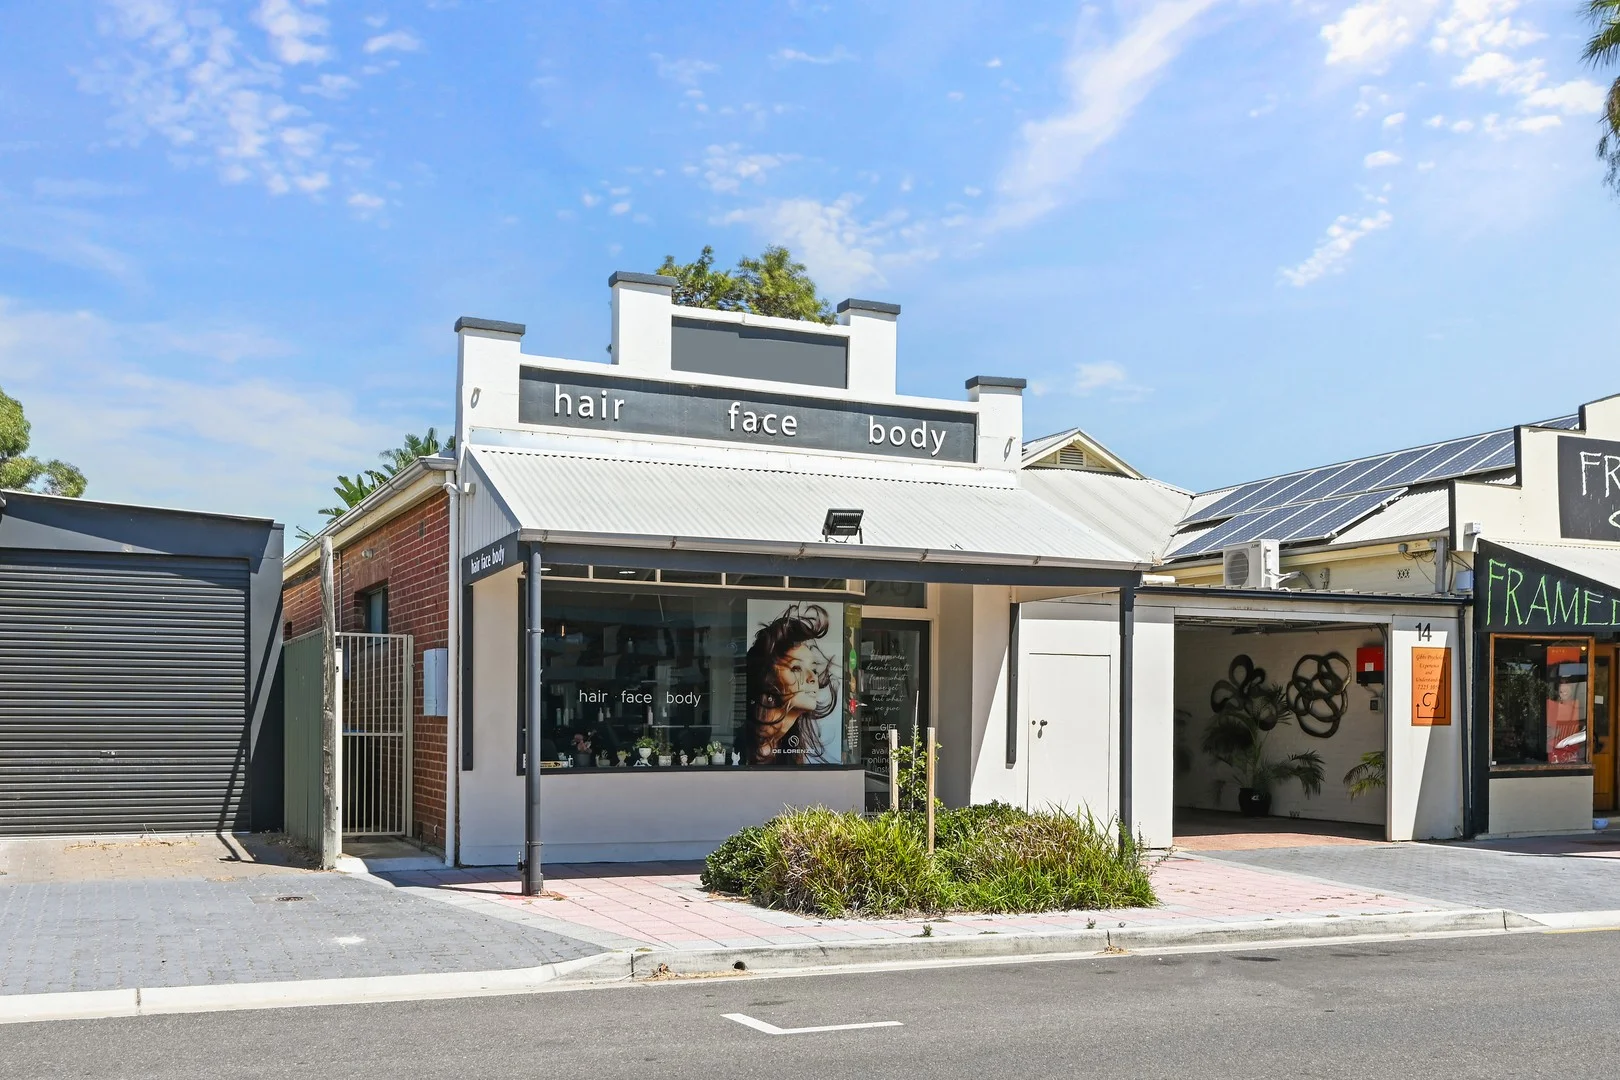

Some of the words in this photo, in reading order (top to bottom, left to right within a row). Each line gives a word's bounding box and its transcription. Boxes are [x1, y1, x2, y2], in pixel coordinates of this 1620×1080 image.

[553, 384, 625, 420] hair
[727, 402, 798, 436] face
[868, 416, 947, 456] body
[470, 557, 480, 575] hair
[480, 553, 491, 570] face
[492, 544, 505, 566] body
[1415, 622, 1432, 642] 14
[579, 689, 608, 703] hair
[620, 690, 653, 704] face
[666, 691, 702, 708] body
[875, 732, 901, 741] CAS
[879, 723, 897, 732] GIFT
